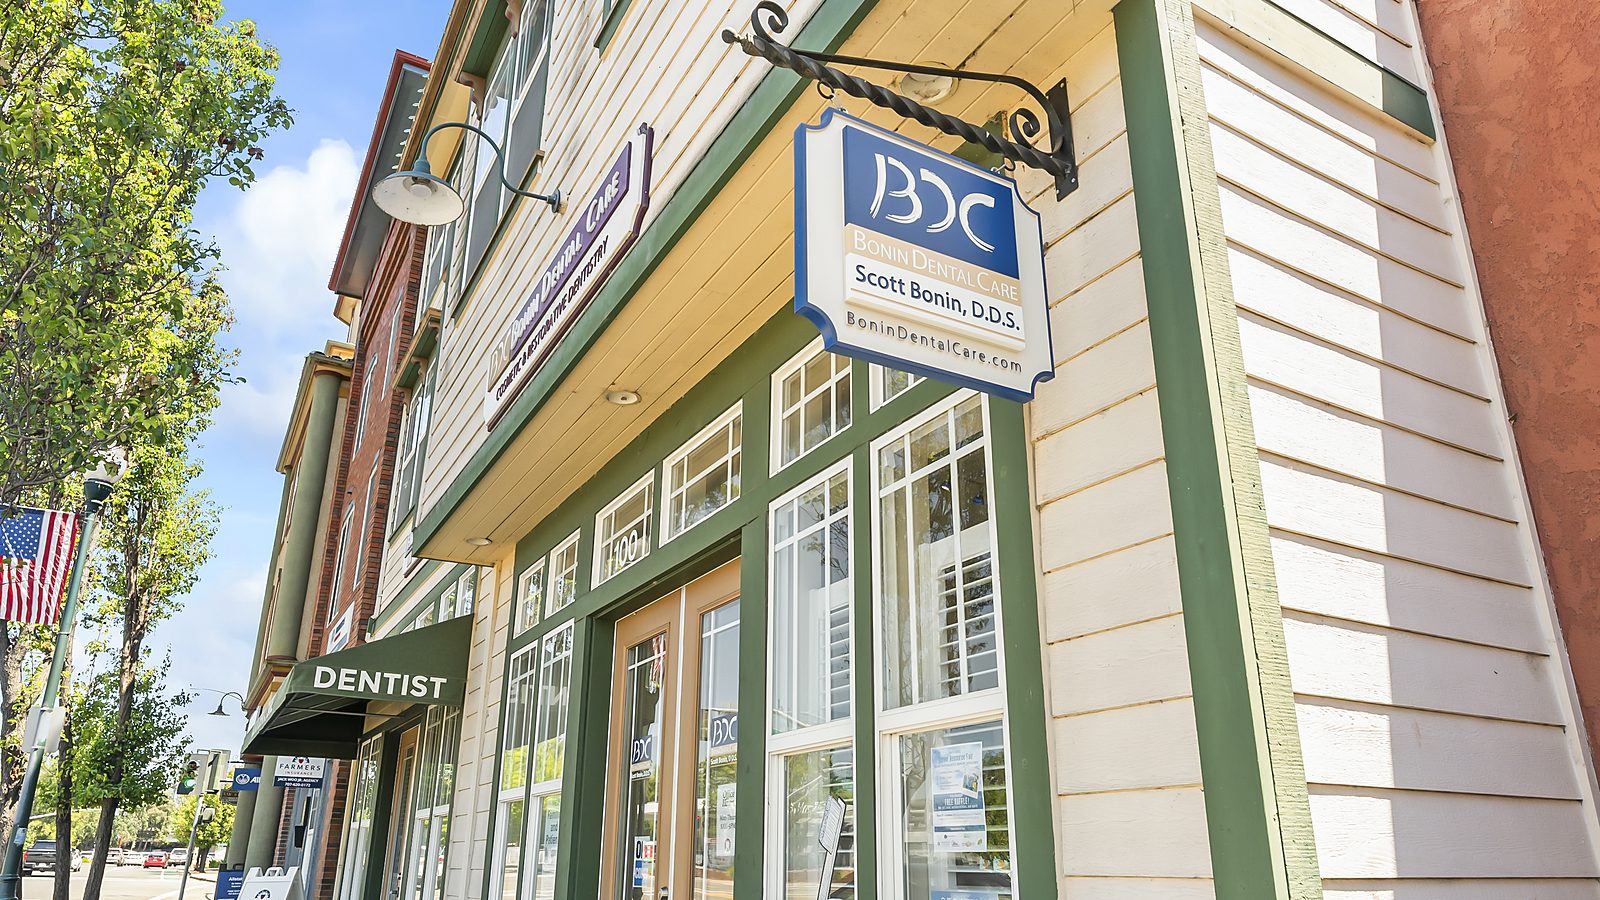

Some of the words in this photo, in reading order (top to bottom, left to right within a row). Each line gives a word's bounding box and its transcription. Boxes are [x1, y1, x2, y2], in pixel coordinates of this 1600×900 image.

[541, 232, 582, 302] DENTAL
[585, 170, 620, 234] CARE
[869, 152, 995, 253] BDC
[567, 235, 609, 303] DENTISTRY
[854, 230, 909, 265] BONIN
[912, 249, 975, 288] DENTAL
[977, 271, 1019, 302] CARE
[855, 264, 905, 296] Scott
[910, 281, 967, 317] Bonin,
[971, 301, 1020, 331] D.D.S.
[846, 311, 1022, 373] BoninDentalCare.com
[613, 529, 638, 573] 100
[313, 665, 447, 699] DENTIST
[279, 763, 321, 771] FARMERS
